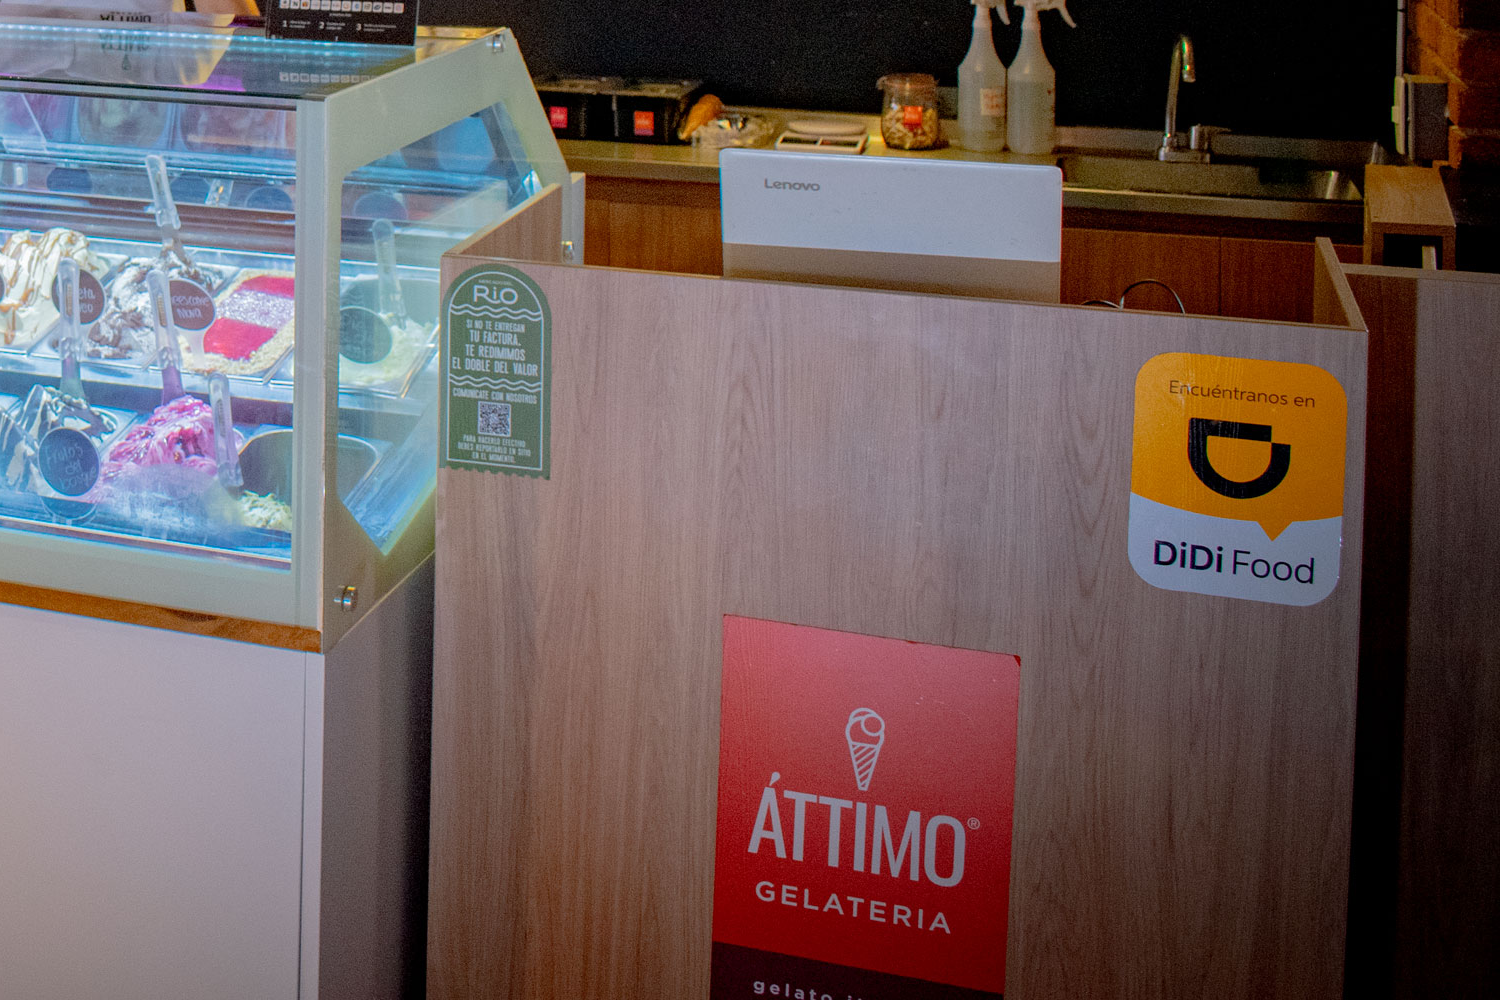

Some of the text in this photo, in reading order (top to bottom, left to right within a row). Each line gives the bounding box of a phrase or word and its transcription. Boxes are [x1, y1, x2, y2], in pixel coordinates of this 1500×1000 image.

[763, 178, 821, 192] Lenovo
[469, 329, 480, 343] TU
[474, 320, 484, 330] NO
[485, 320, 493, 331] TE
[494, 321, 526, 333] ENTREGAN
[465, 343, 526, 361] TE REDIMIMOS
[451, 356, 539, 377] EL DOBLE DEL VALOR
[1168, 379, 1316, 409] Encuéntranos en
[1153, 539, 1315, 585] DiDi Food
[755, 880, 951, 935] GELATERIA
